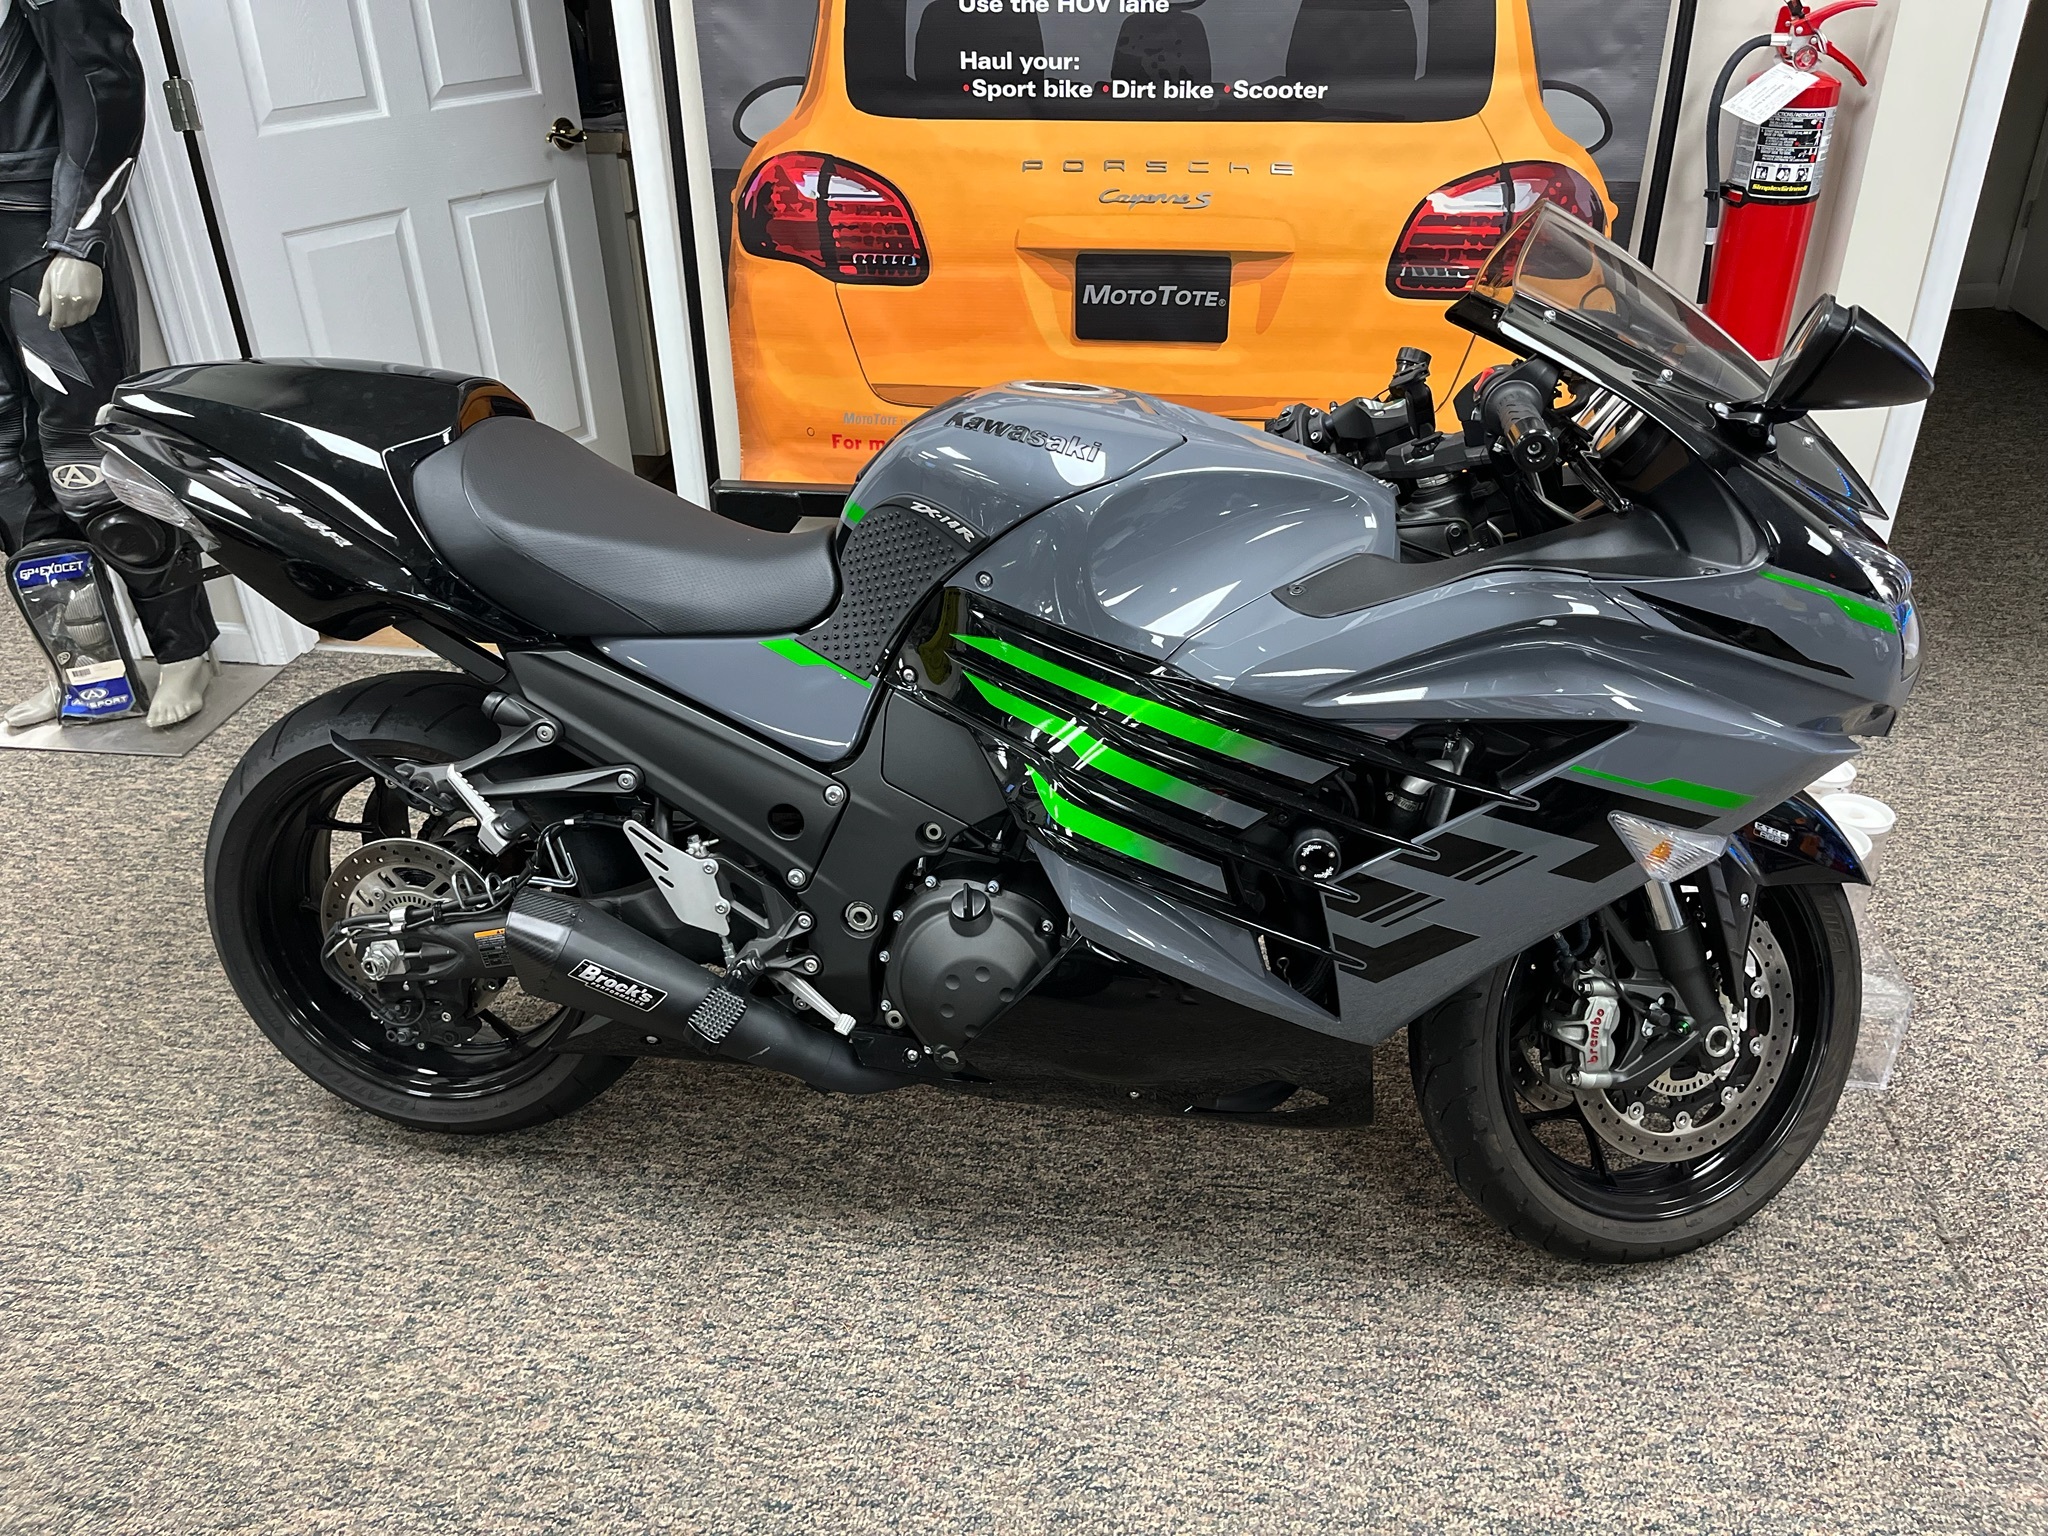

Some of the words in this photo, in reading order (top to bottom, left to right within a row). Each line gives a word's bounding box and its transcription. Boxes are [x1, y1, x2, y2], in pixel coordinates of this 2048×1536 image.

[958, 0, 1004, 13] Use
[1011, 0, 1050, 13] the
[1057, 0, 1109, 13] HOV
[1119, 0, 1170, 13] lane
[960, 51, 1013, 71] Haul
[1019, 54, 1080, 75] your:
[972, 80, 1037, 102] Sport
[1044, 80, 1093, 98] bike
[1111, 80, 1159, 99] Dirt
[1163, 81, 1214, 99] bike
[1233, 80, 1329, 99] Scooter
[1021, 159, 1295, 176] PORSCHE
[831, 433, 862, 450] For
[944, 411, 1103, 463] Kawasaki
[910, 501, 975, 543] ZX-14R
[578, 964, 653, 1003] Brock's
[590, 981, 646, 1007] PERFORMANCE
[1586, 1007, 1606, 1065] brembo
